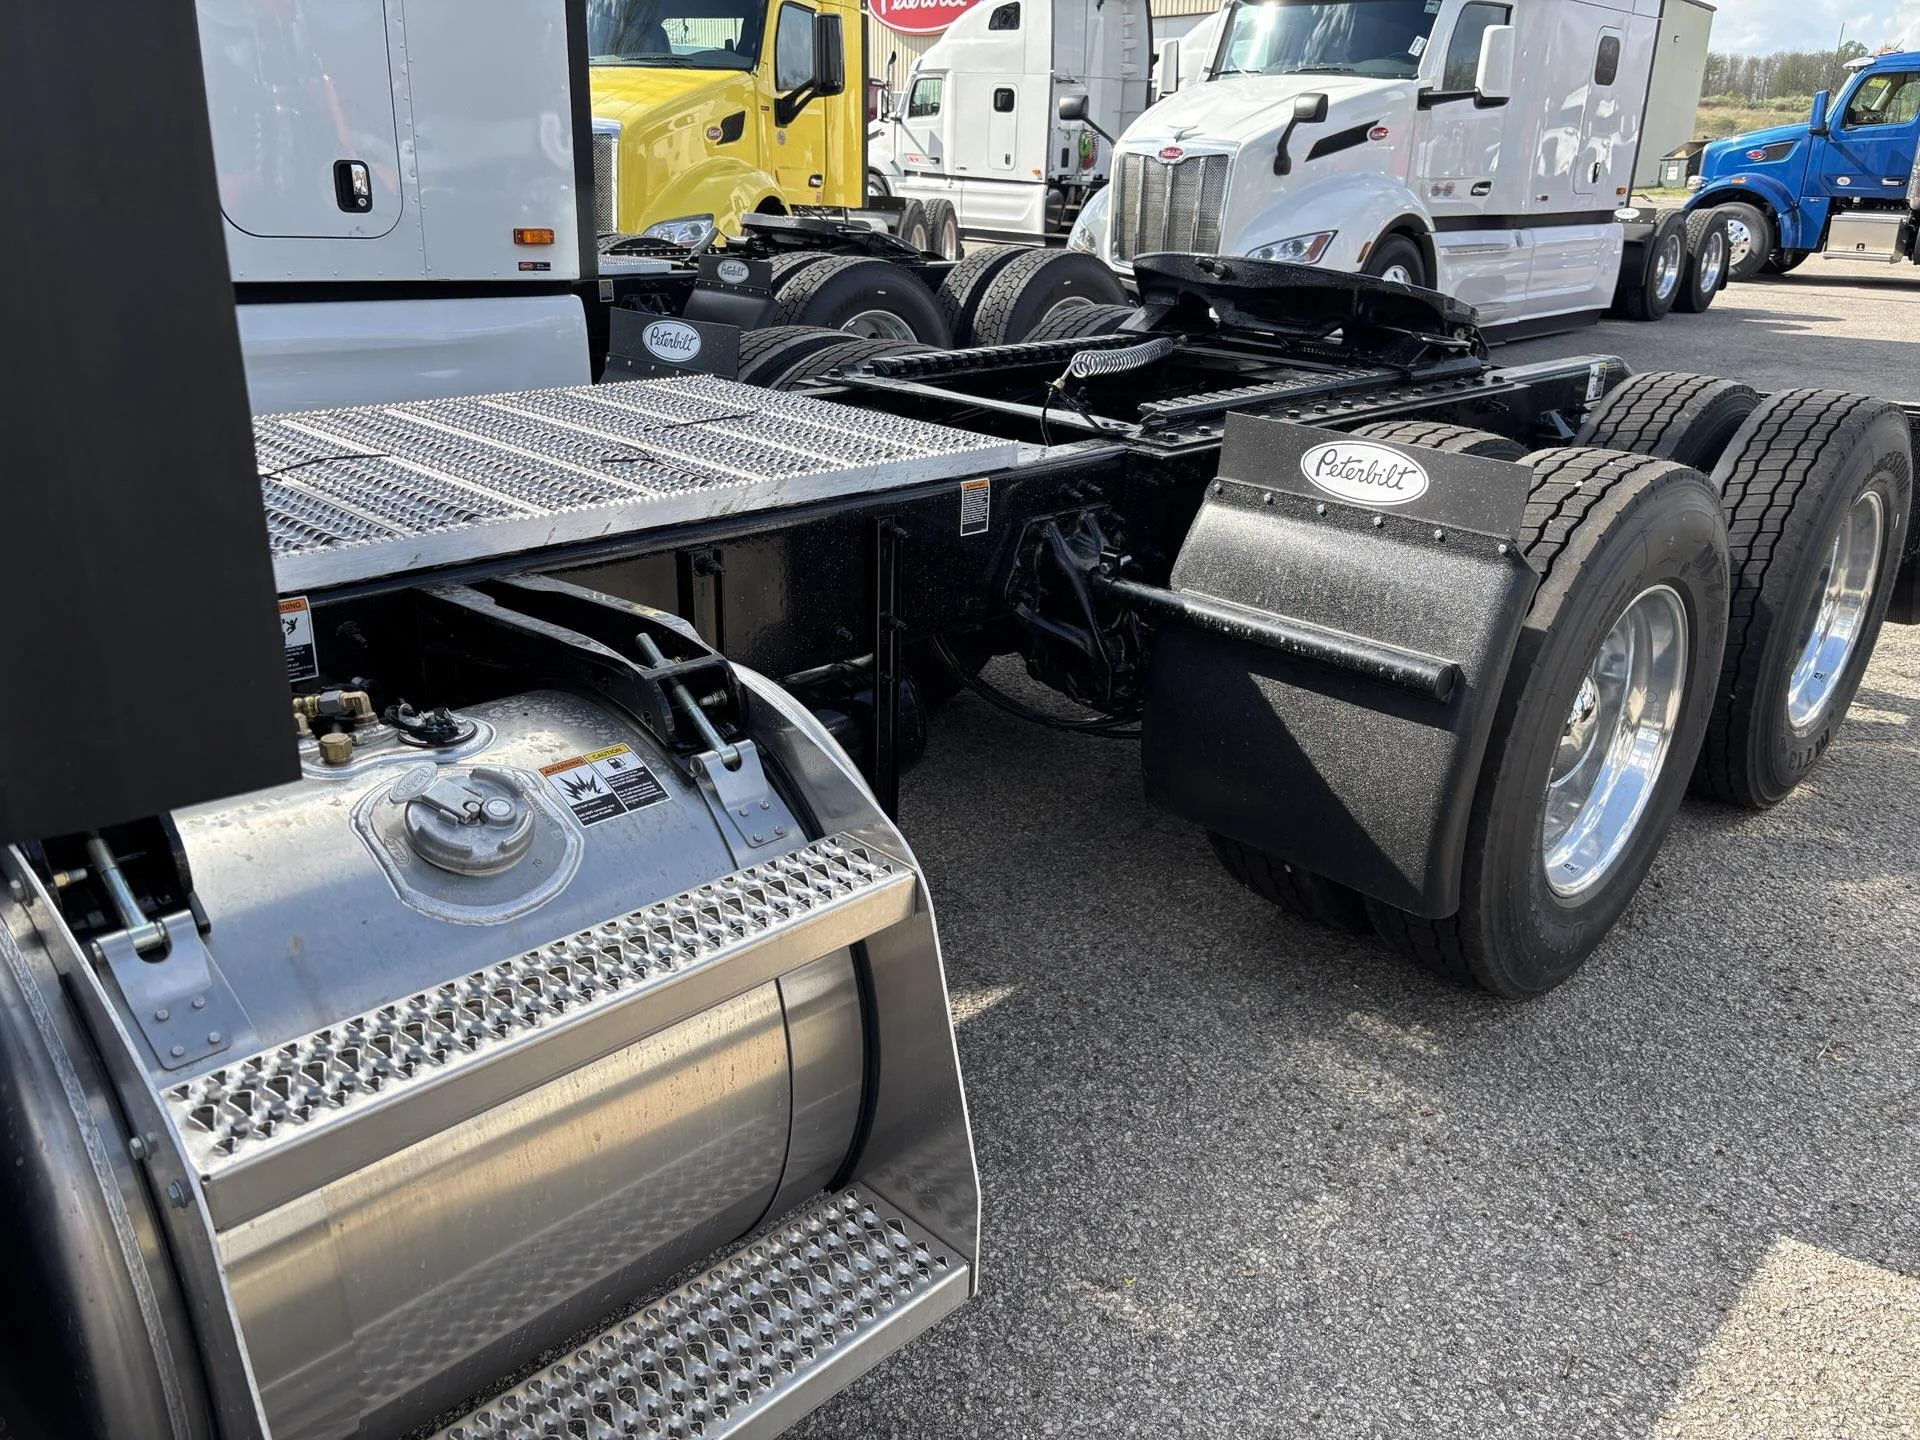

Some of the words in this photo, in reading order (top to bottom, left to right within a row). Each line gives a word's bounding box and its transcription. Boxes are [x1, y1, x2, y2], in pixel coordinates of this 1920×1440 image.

[650, 326, 697, 351] Peterbilt
[1315, 448, 1417, 490] Peterbilt
[280, 602, 302, 612] NING
[592, 747, 623, 760] CAUTION
